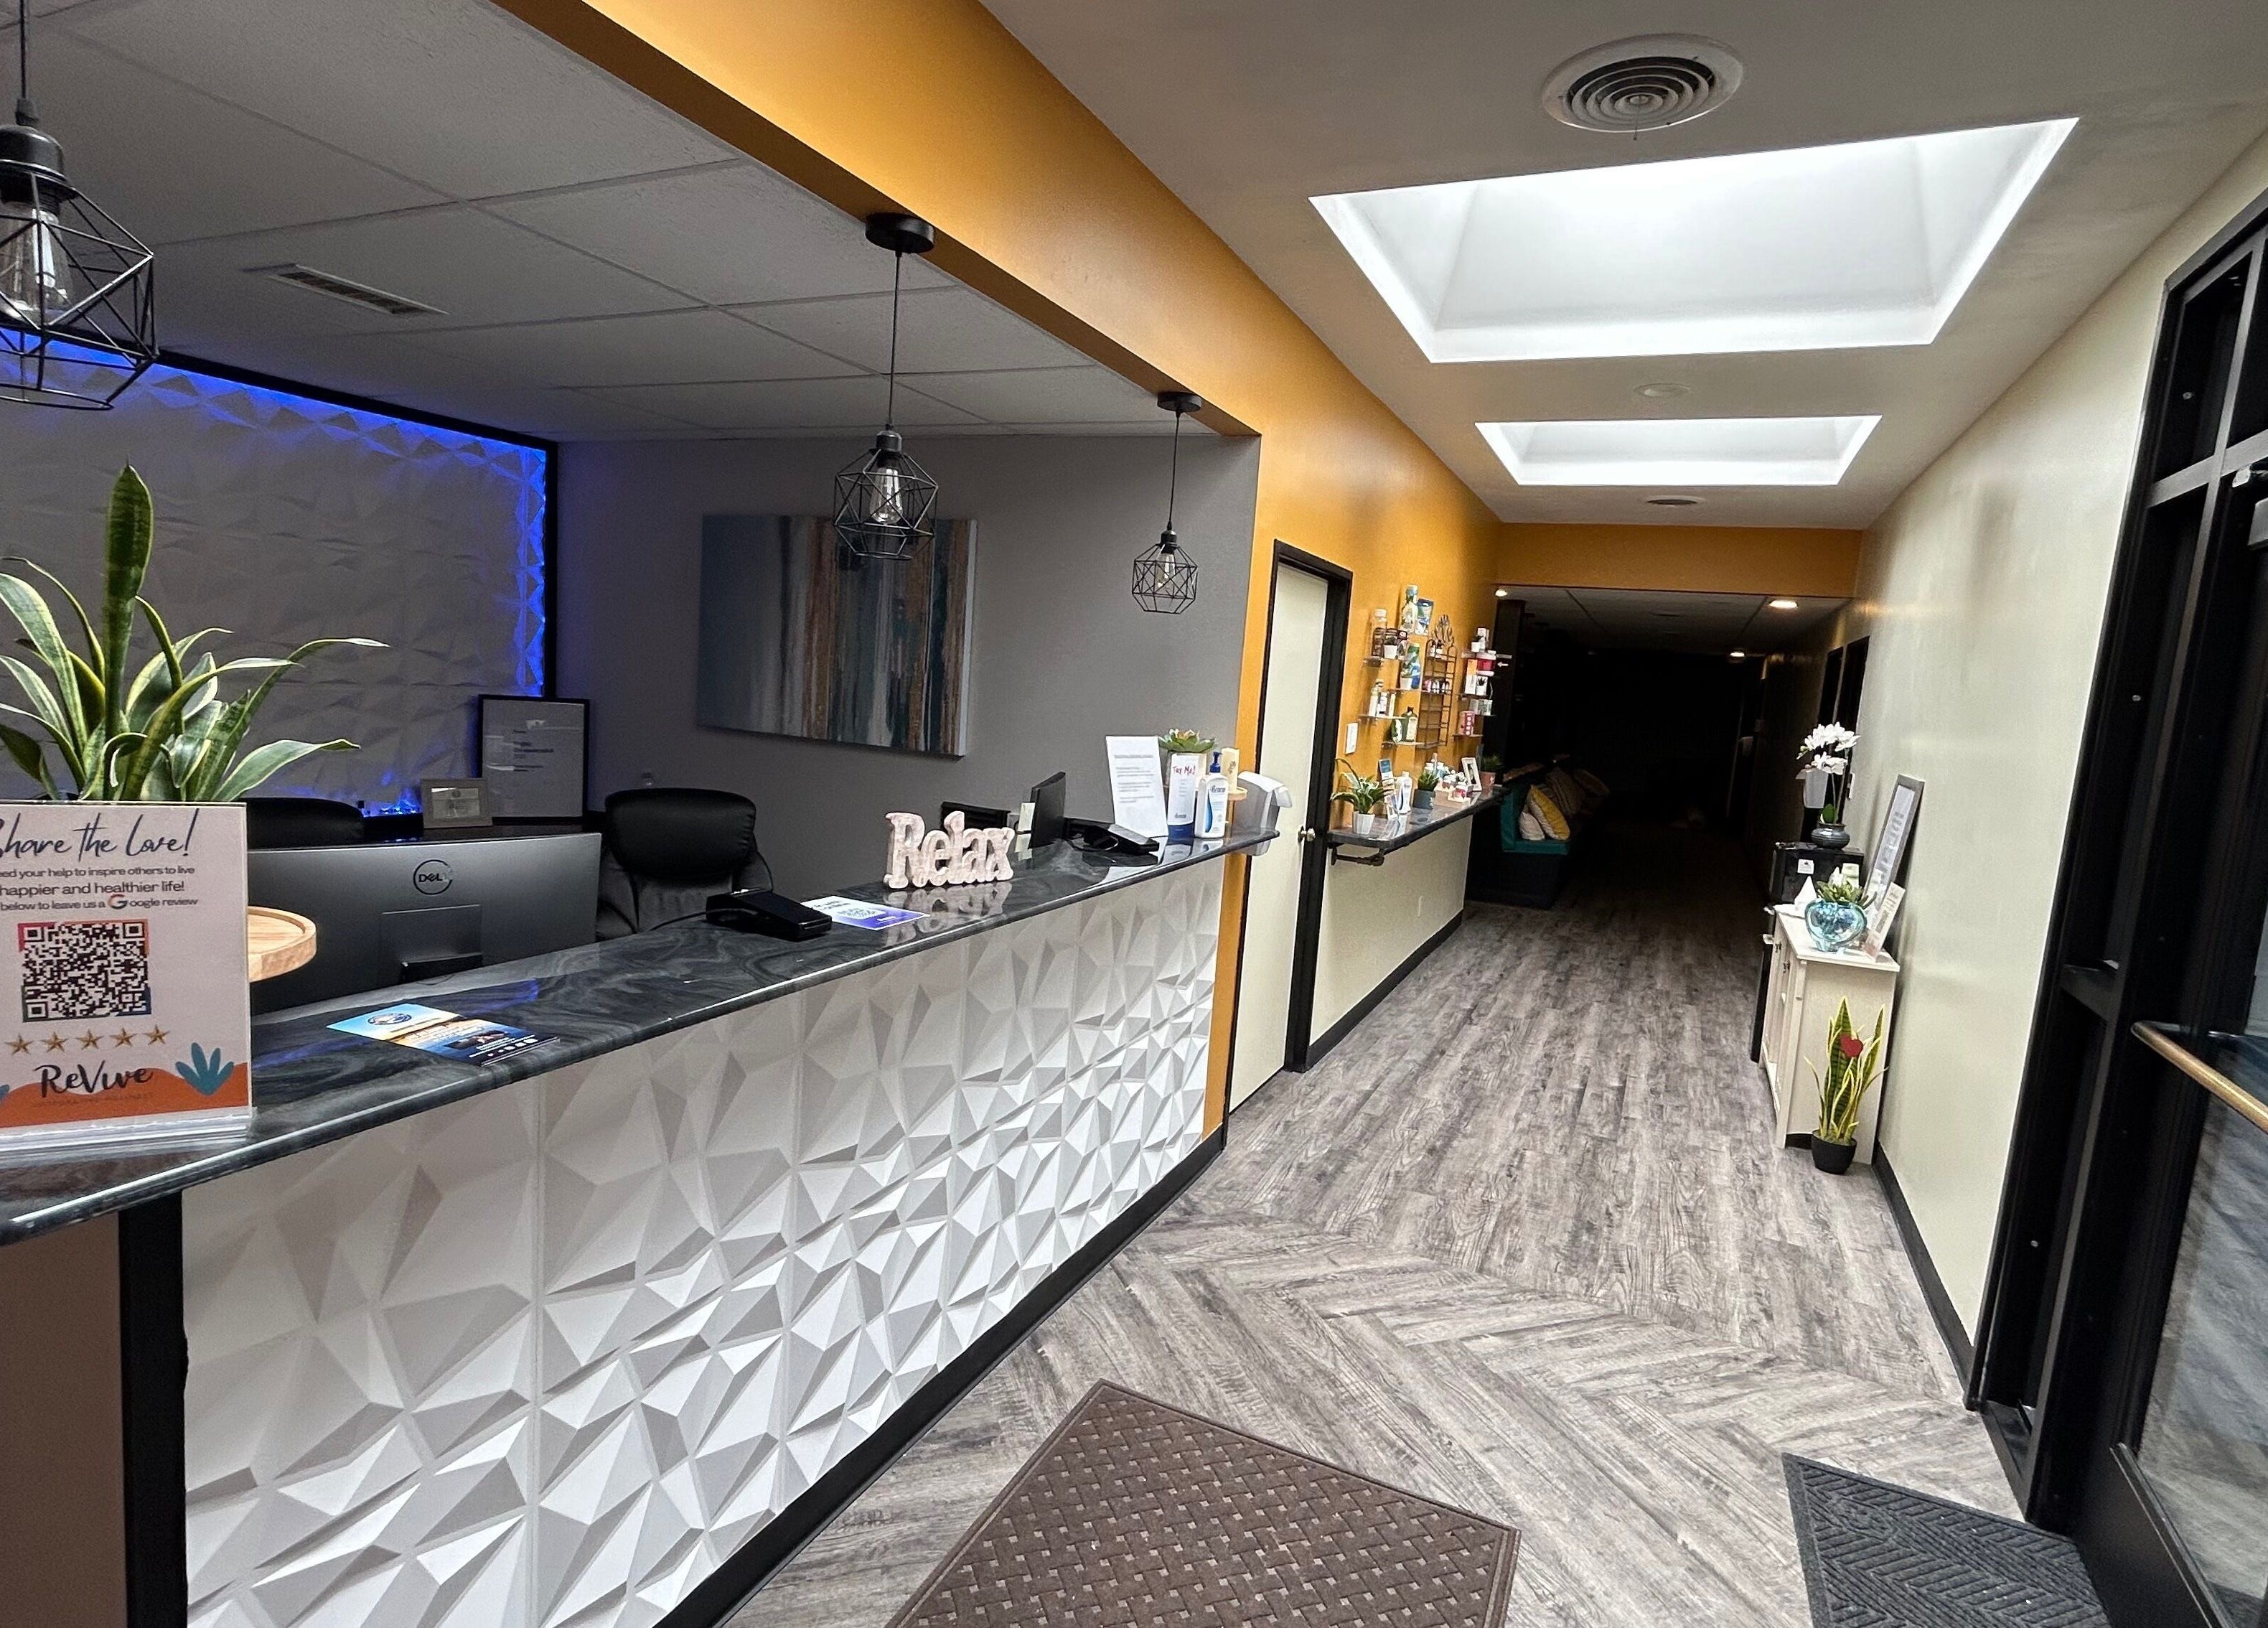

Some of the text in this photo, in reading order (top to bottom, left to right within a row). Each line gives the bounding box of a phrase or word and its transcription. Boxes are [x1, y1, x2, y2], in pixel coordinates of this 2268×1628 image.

[0, 808, 200, 862] hare the Love!
[884, 810, 1016, 889] Relax
[19, 870, 47, 879] your
[48, 868, 73, 878] help
[75, 868, 86, 876] to
[88, 866, 126, 877] inspire
[127, 866, 164, 875] others
[177, 865, 195, 874] live
[0, 880, 185, 898] happier and healthier life!
[0, 902, 36, 911] below
[37, 902, 50, 910] to
[52, 900, 82, 909] leave
[108, 894, 161, 909] Google
[33, 1059, 154, 1098] ReVive
